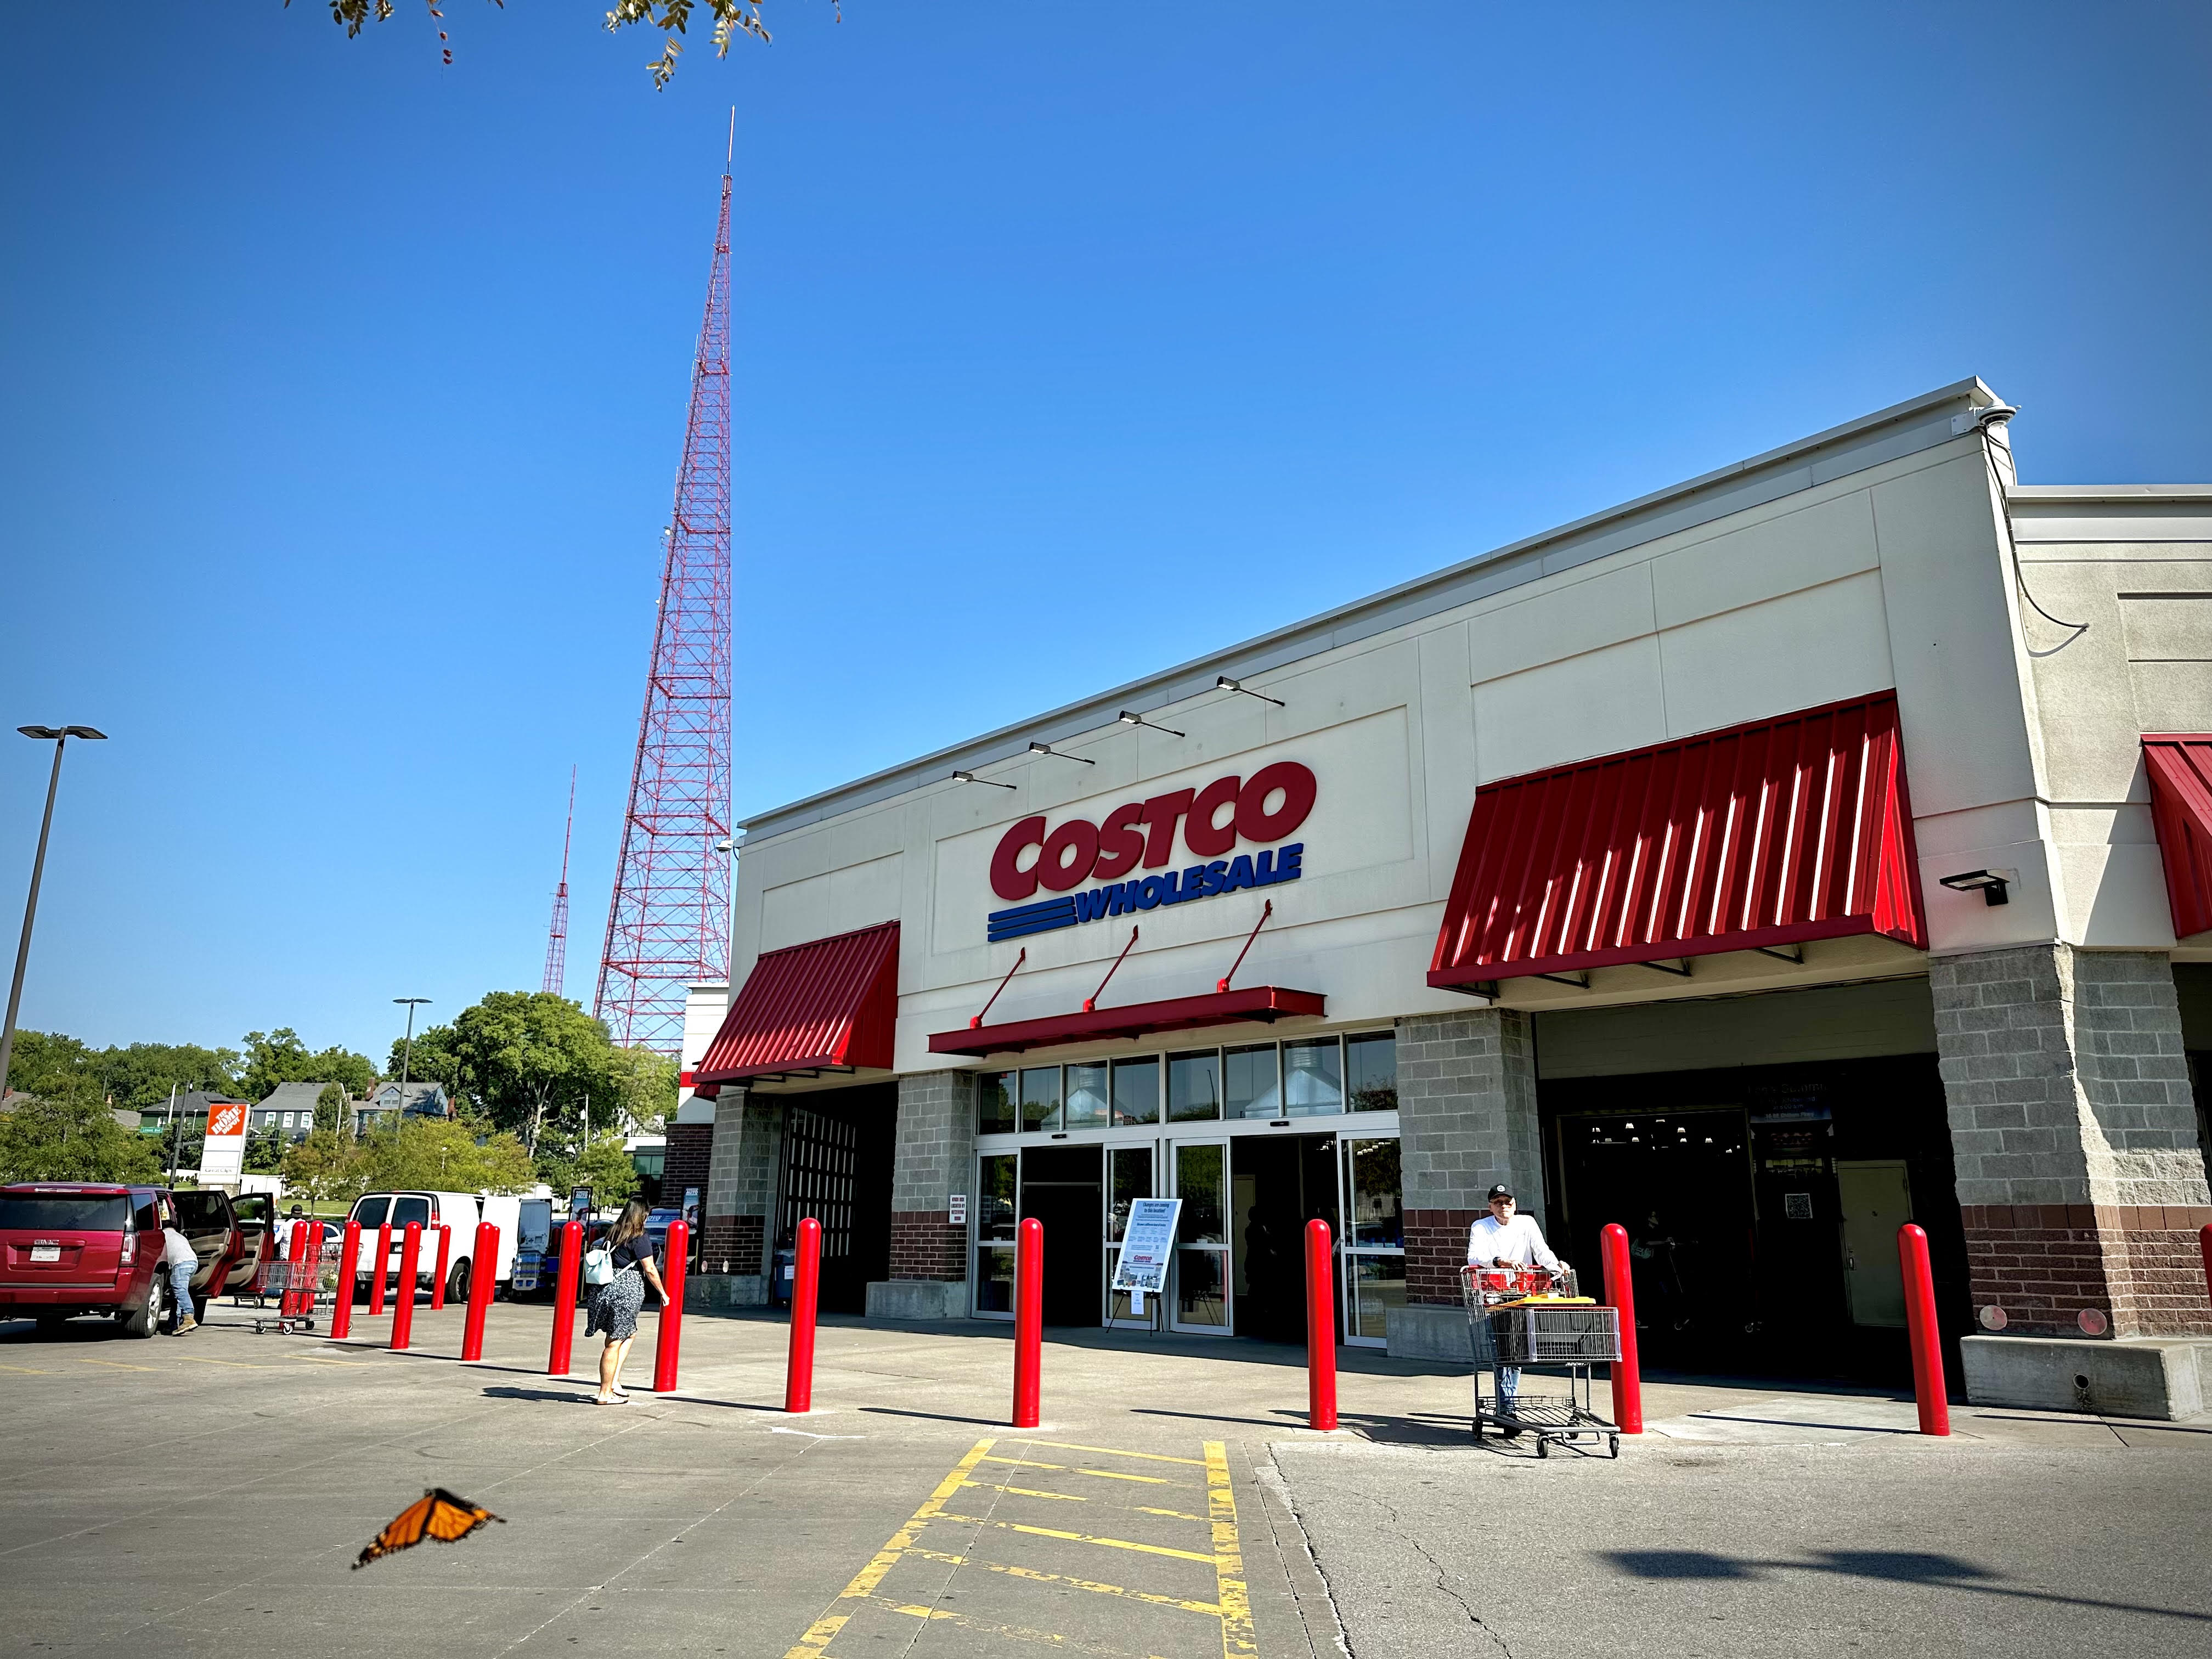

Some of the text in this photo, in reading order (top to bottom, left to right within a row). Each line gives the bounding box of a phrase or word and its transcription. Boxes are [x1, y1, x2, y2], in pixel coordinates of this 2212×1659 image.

[990, 761, 1317, 901] COSTCO
[1075, 843, 1304, 923] WHOLESALE
[211, 1105, 242, 1135] HOME
[215, 1109, 228, 1120] THE
